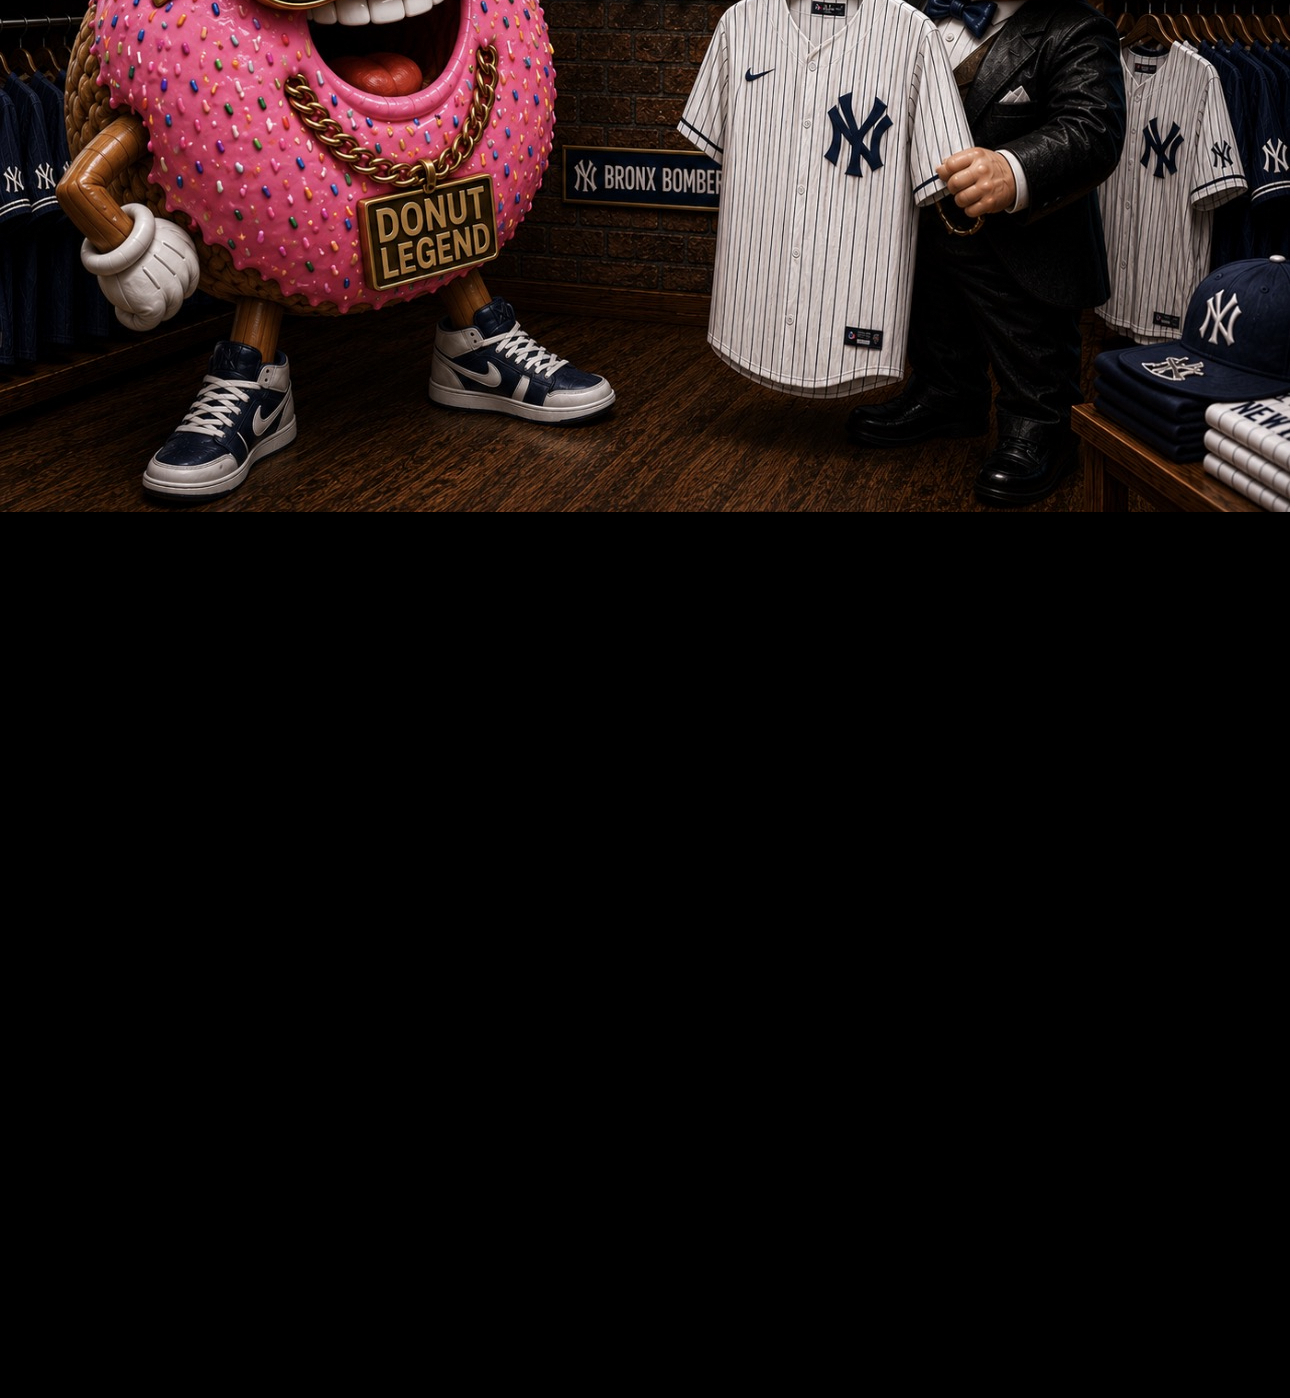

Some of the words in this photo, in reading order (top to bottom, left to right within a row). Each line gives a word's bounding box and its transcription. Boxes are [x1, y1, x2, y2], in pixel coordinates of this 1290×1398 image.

[824, 91, 893, 178] NY
[1140, 117, 1185, 179] NY
[1211, 140, 1234, 169] NY
[1262, 138, 1290, 173] NY
[3, 165, 24, 193] NY
[35, 162, 56, 190] NY
[574, 159, 597, 192] NY
[604, 164, 657, 192] BRONX
[376, 186, 486, 244] DONUT
[379, 224, 491, 280] LEGEND
[1199, 289, 1242, 346] NY
[1230, 401, 1290, 430] NEW
